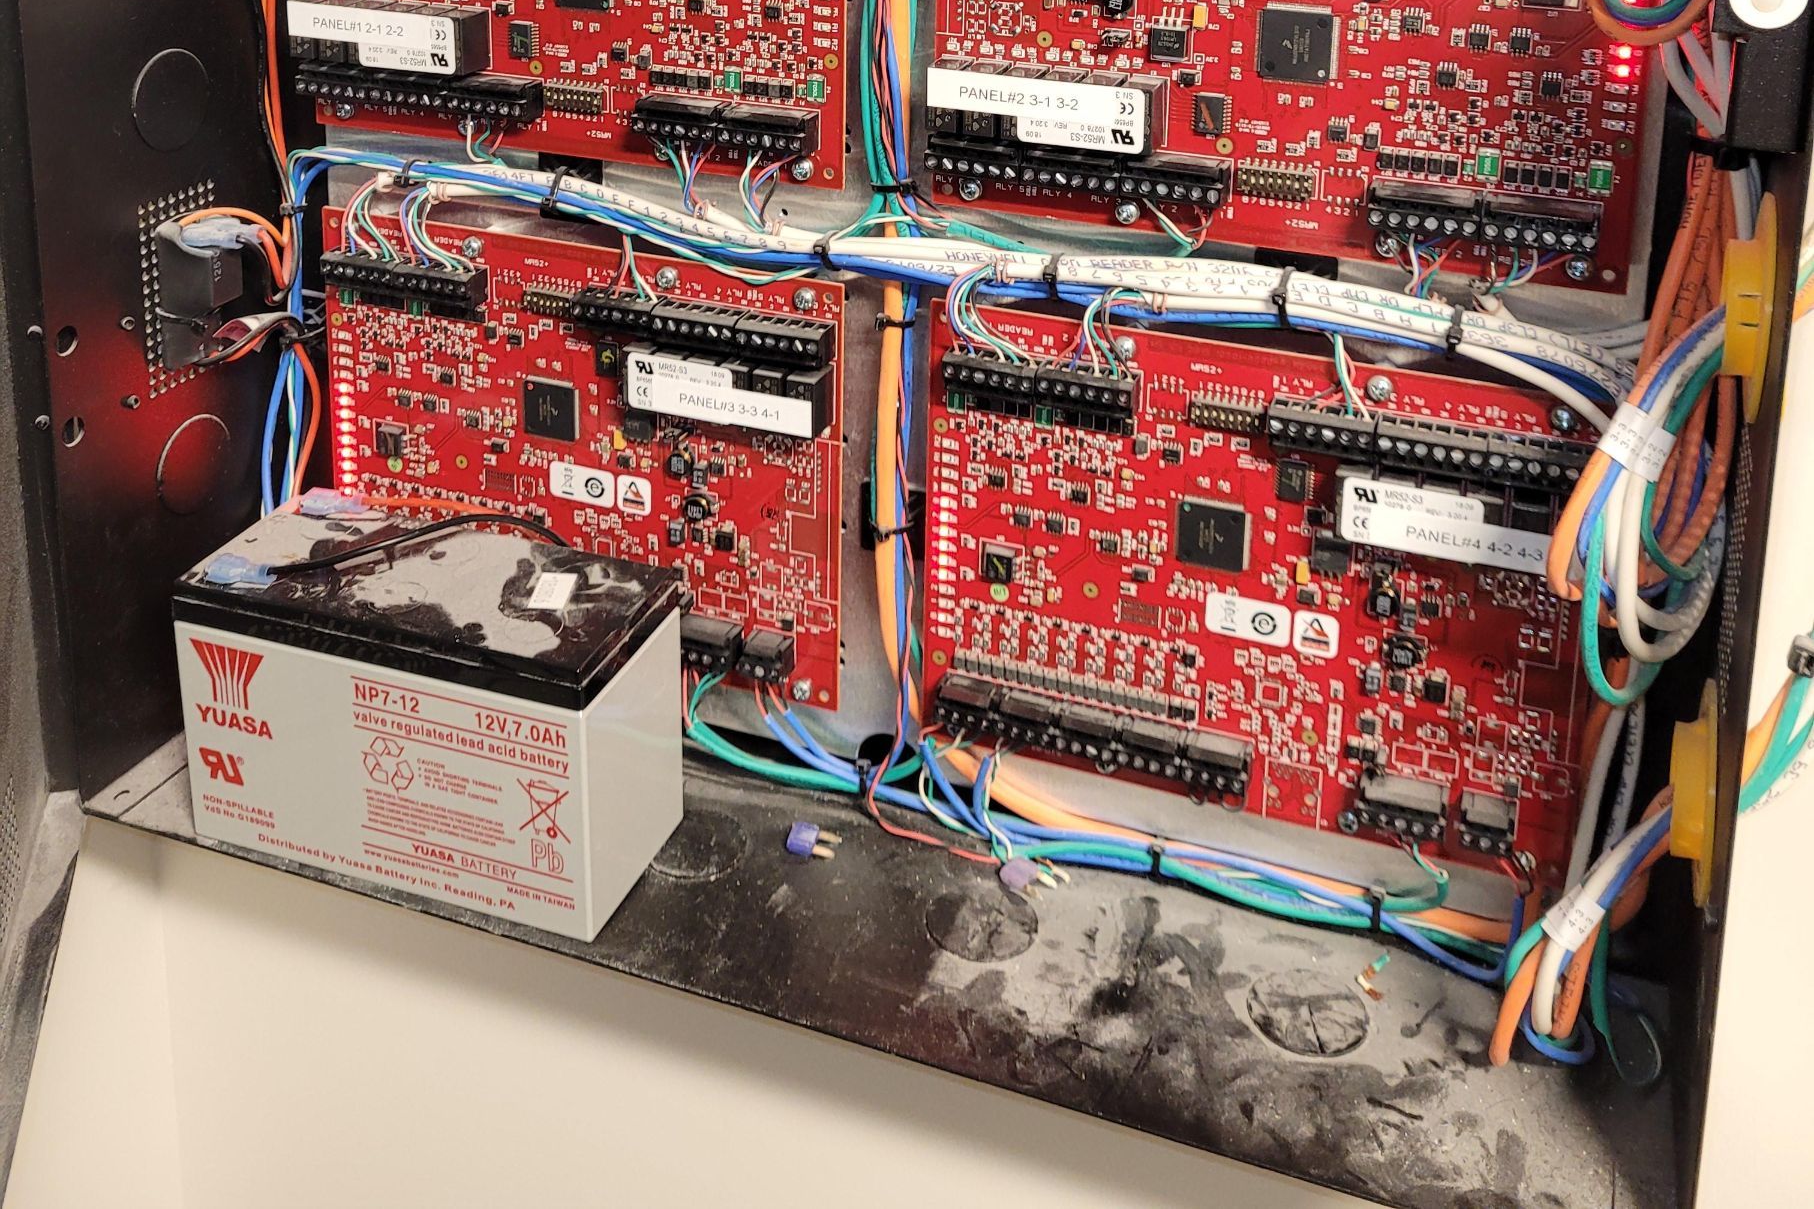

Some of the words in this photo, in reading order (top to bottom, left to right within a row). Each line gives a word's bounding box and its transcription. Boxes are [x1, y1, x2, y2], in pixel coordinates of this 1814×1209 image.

[312, 17, 362, 32] PANEL#1
[366, 23, 381, 34] 2-1
[386, 25, 404, 37] 2-2
[959, 86, 1025, 106] PANEL#2
[1029, 95, 1050, 107] 3-1
[1057, 97, 1079, 110] 3-2
[995, 182, 1013, 191] RLY
[1043, 189, 1060, 198] RLY
[1091, 194, 1109, 203] RLY
[739, 404, 758, 415] 3-3
[761, 408, 779, 421] 4-1
[1406, 525, 1481, 549] PANEL#4
[1487, 541, 1512, 556] 4-2
[1517, 547, 1543, 561] 4-3
[354, 682, 419, 713] NP7-12
[196, 703, 272, 739] YUASA
[474, 712, 566, 749] 12V,7.0Ah
[353, 710, 387, 727] valve
[391, 718, 453, 743] regulated
[456, 733, 484, 751] lead
[488, 741, 516, 759] acid
[520, 748, 569, 774] battery
[417, 758, 445, 769] CAUTION
[203, 794, 275, 819] NON-SPILLABLE
[412, 843, 454, 863] YUASA
[460, 856, 517, 880] BATTERY
[531, 838, 564, 874] Pb
[258, 833, 319, 857] Distributed
[322, 850, 335, 862] by
[339, 855, 372, 871] Yuasa
[375, 866, 417, 884] Battery
[420, 877, 440, 890] Inc.
[444, 883, 496, 906] Reading,
[499, 900, 515, 910] PA
[506, 886, 530, 899] MADE
[532, 893, 541, 901] IN
[543, 895, 575, 910] TAIWAN
